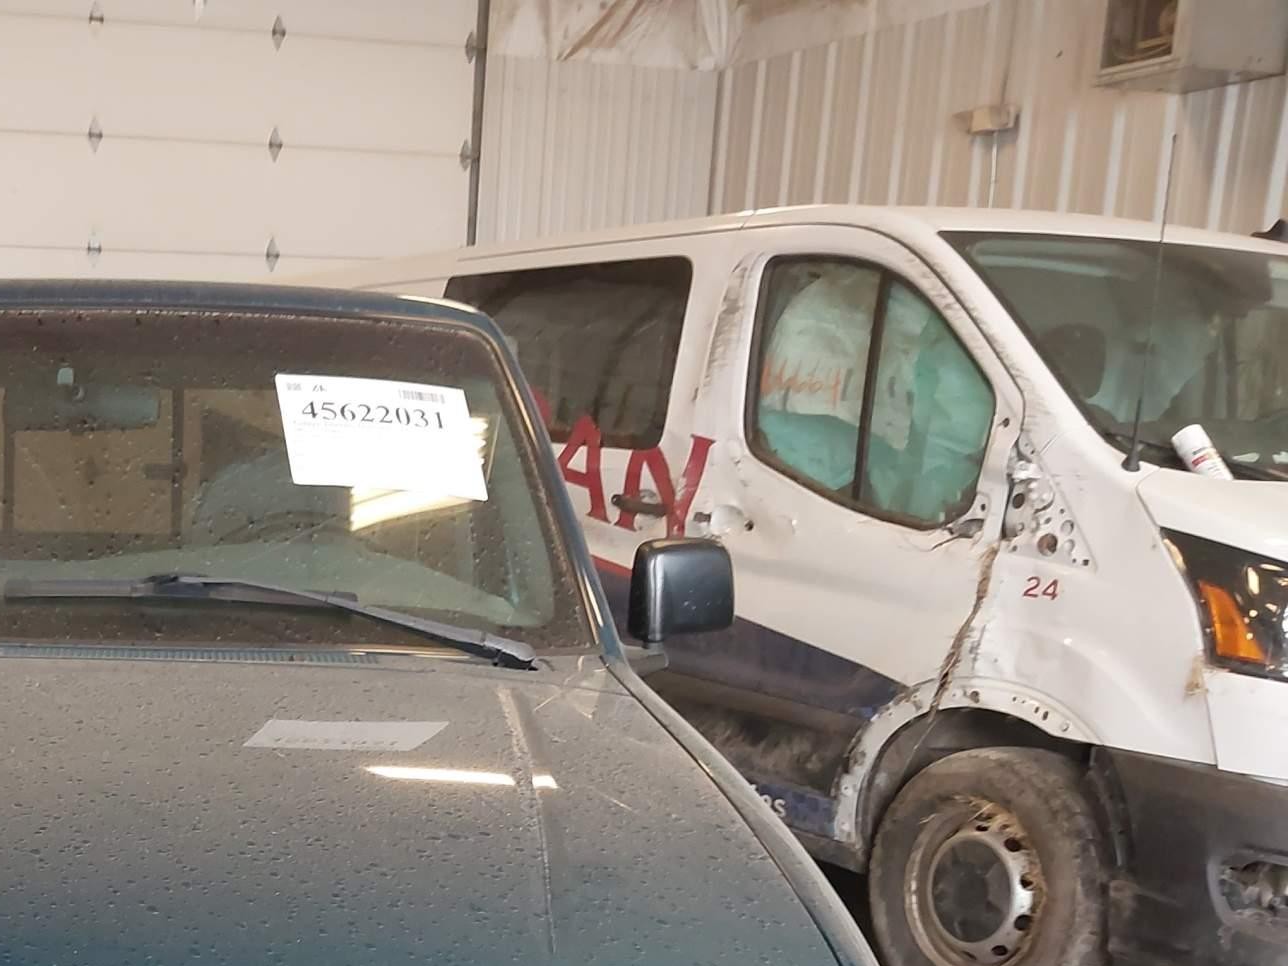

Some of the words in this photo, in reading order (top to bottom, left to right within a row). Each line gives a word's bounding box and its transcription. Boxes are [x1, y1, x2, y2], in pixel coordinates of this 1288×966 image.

[301, 399, 445, 430] 45622031
[534, 387, 716, 540] AN
[1022, 575, 1059, 601] 24
